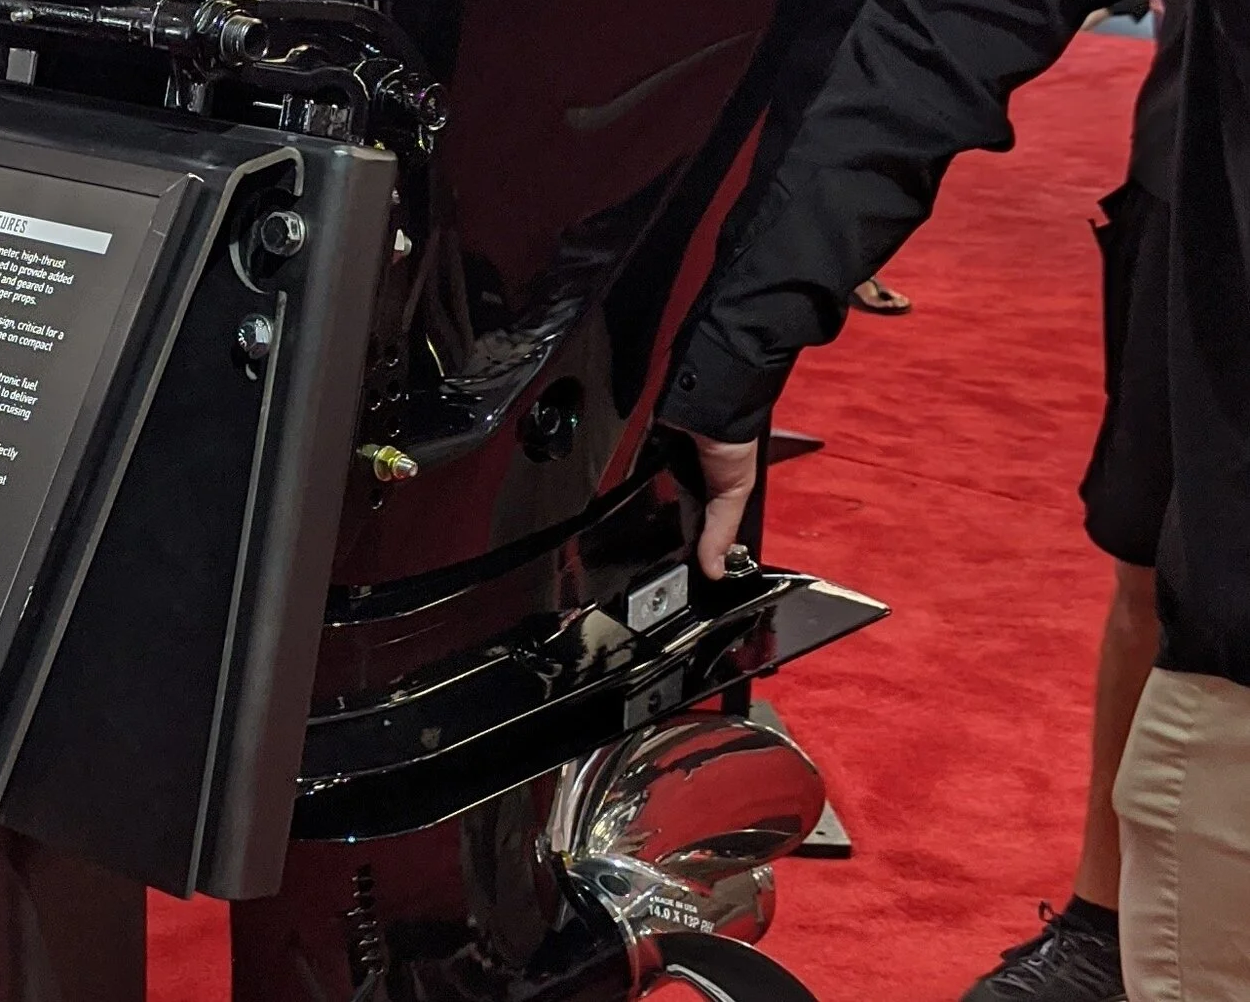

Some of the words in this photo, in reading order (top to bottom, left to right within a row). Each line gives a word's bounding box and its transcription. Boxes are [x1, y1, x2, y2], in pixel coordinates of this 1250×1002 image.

[20, 249, 66, 269] high-thrust
[17, 263, 48, 279] provide
[47, 271, 75, 285] added
[0, 275, 18, 286] and
[15, 279, 46, 293] geared
[17, 321, 46, 336] critical
[45, 325, 59, 338] for
[18, 336, 54, 352] compact
[21, 377, 39, 392] fuel
[9, 389, 38, 405] deliver
[649, 904, 670, 919] 14.0
